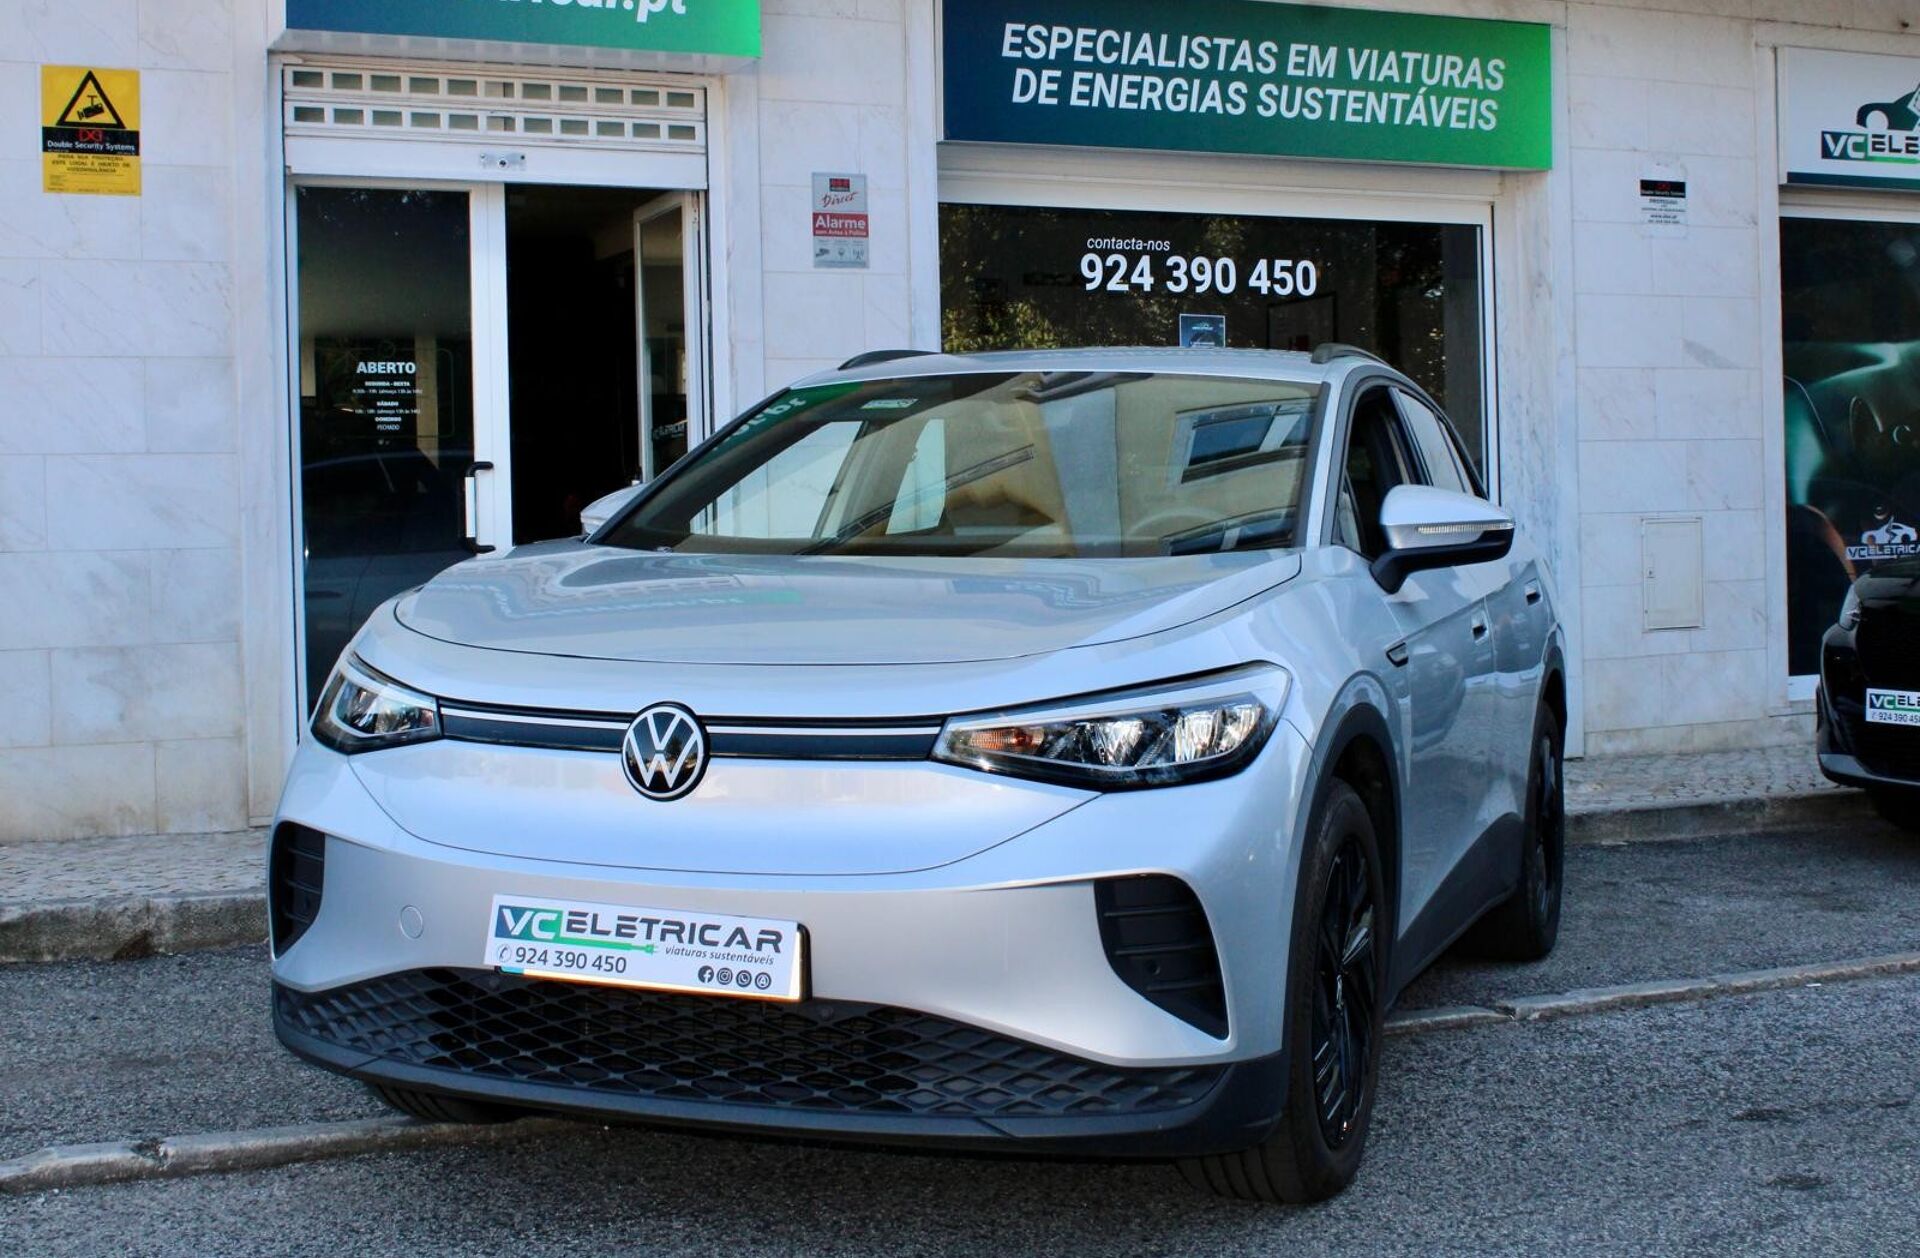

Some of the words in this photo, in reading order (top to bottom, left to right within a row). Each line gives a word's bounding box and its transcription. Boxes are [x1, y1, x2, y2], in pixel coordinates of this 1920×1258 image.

[1001, 22, 1279, 74] ESPECIALISTAS
[1286, 43, 1338, 79] EM
[1347, 47, 1506, 92] VIATURAS
[1011, 67, 1062, 105] DE
[1069, 70, 1249, 116] ENERGIAS
[1256, 83, 1499, 132] SUSTENTÁVEIS
[47, 140, 73, 148] Double
[75, 142, 104, 151] Security
[105, 143, 135, 151] Systems
[815, 214, 865, 229] Alarme
[1086, 236, 1171, 252] contacta-nos
[1080, 252, 1155, 293] 924
[1165, 255, 1238, 294] 390
[1248, 258, 1318, 297] 450
[356, 361, 417, 375] ABERTO
[498, 906, 784, 954] VCELETRICAR
[514, 946, 549, 967] 924
[552, 950, 588, 970] 390
[591, 954, 628, 974] 450
[665, 945, 708, 959] viaturas
[709, 951, 775, 966] sustentáveis
